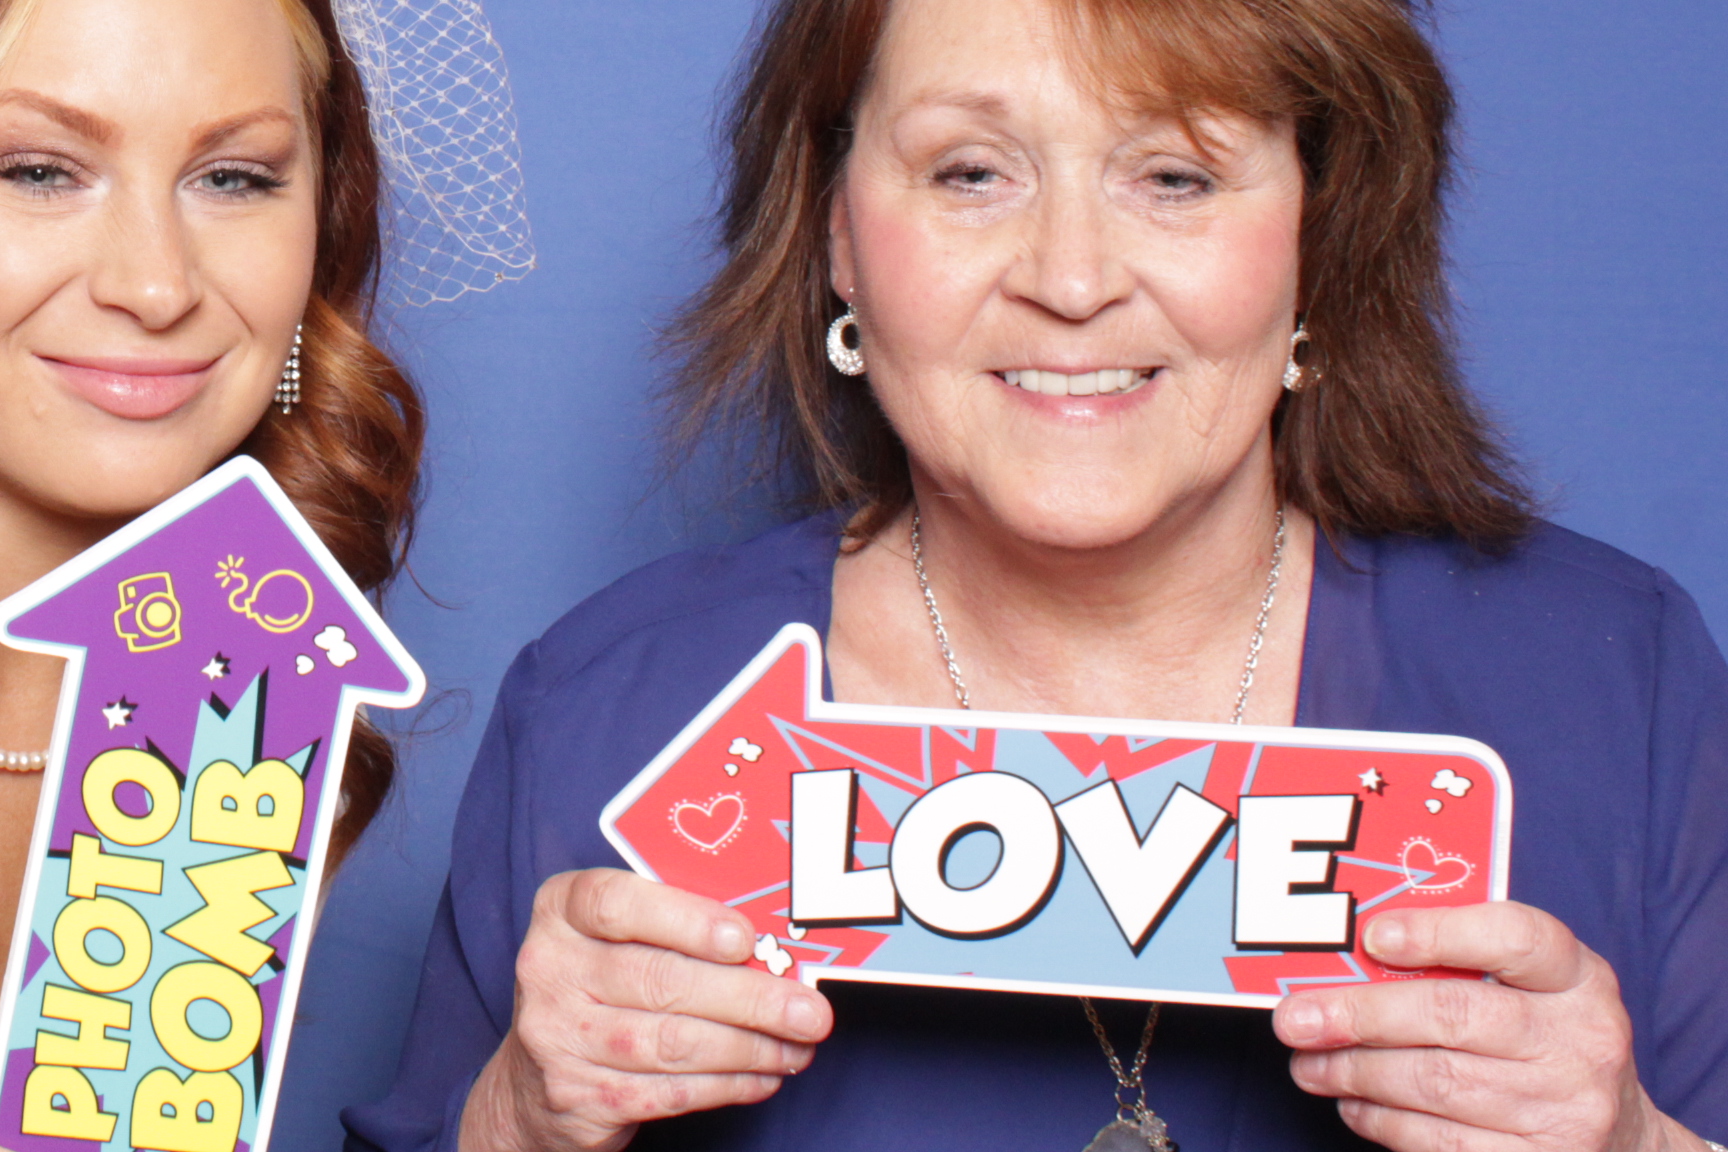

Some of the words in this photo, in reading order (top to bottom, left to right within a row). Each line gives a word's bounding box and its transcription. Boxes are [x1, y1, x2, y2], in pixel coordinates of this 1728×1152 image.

[21, 747, 182, 1142] PHOTO
[129, 758, 305, 1152] BOMB
[789, 767, 1362, 957] LOVE
